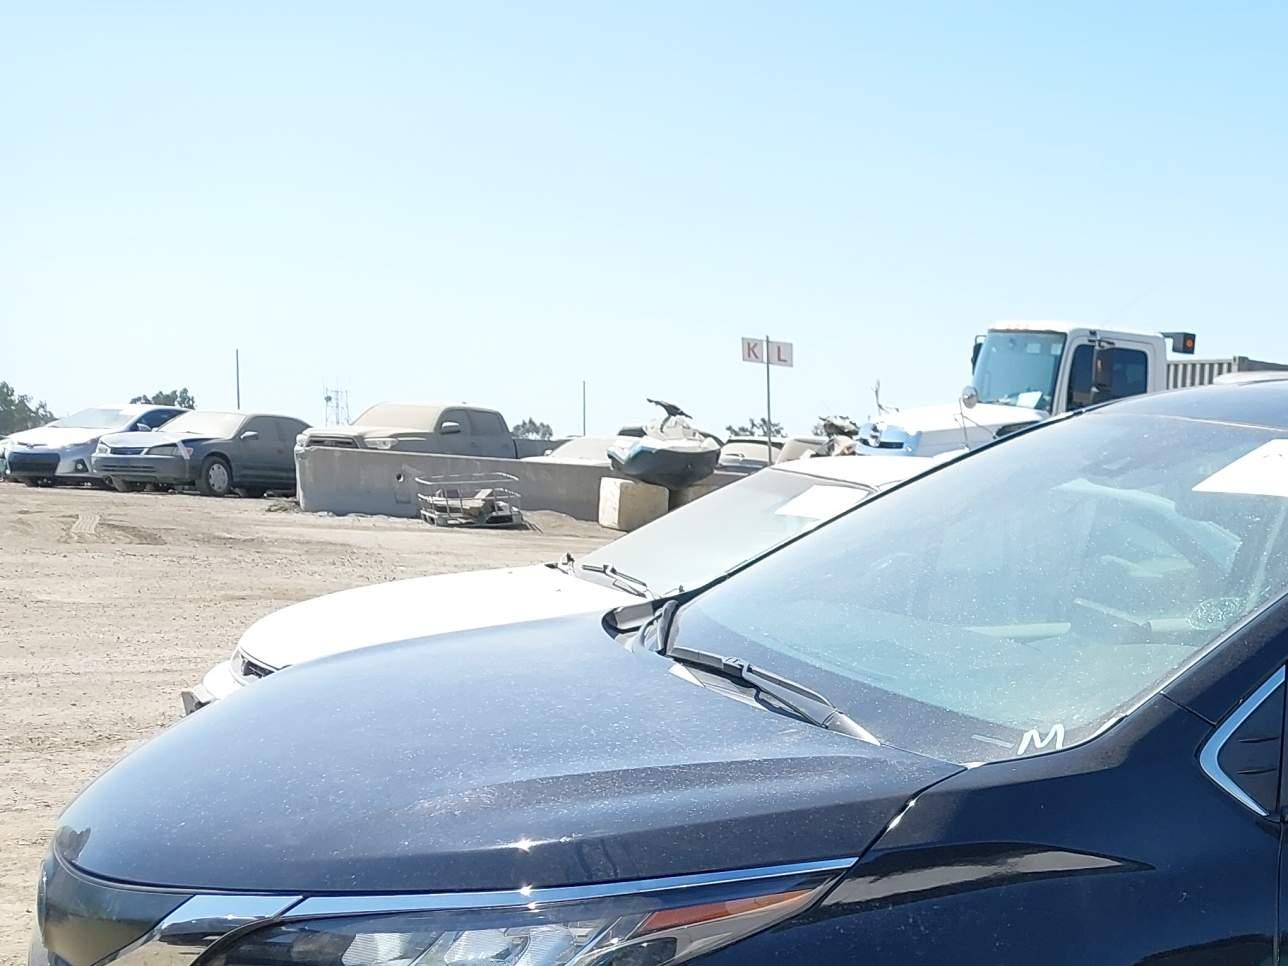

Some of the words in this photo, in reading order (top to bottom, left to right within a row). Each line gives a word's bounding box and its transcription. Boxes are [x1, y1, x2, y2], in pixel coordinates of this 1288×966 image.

[747, 341, 759, 359] K
[776, 345, 788, 363] L
[1017, 723, 1065, 755] M
